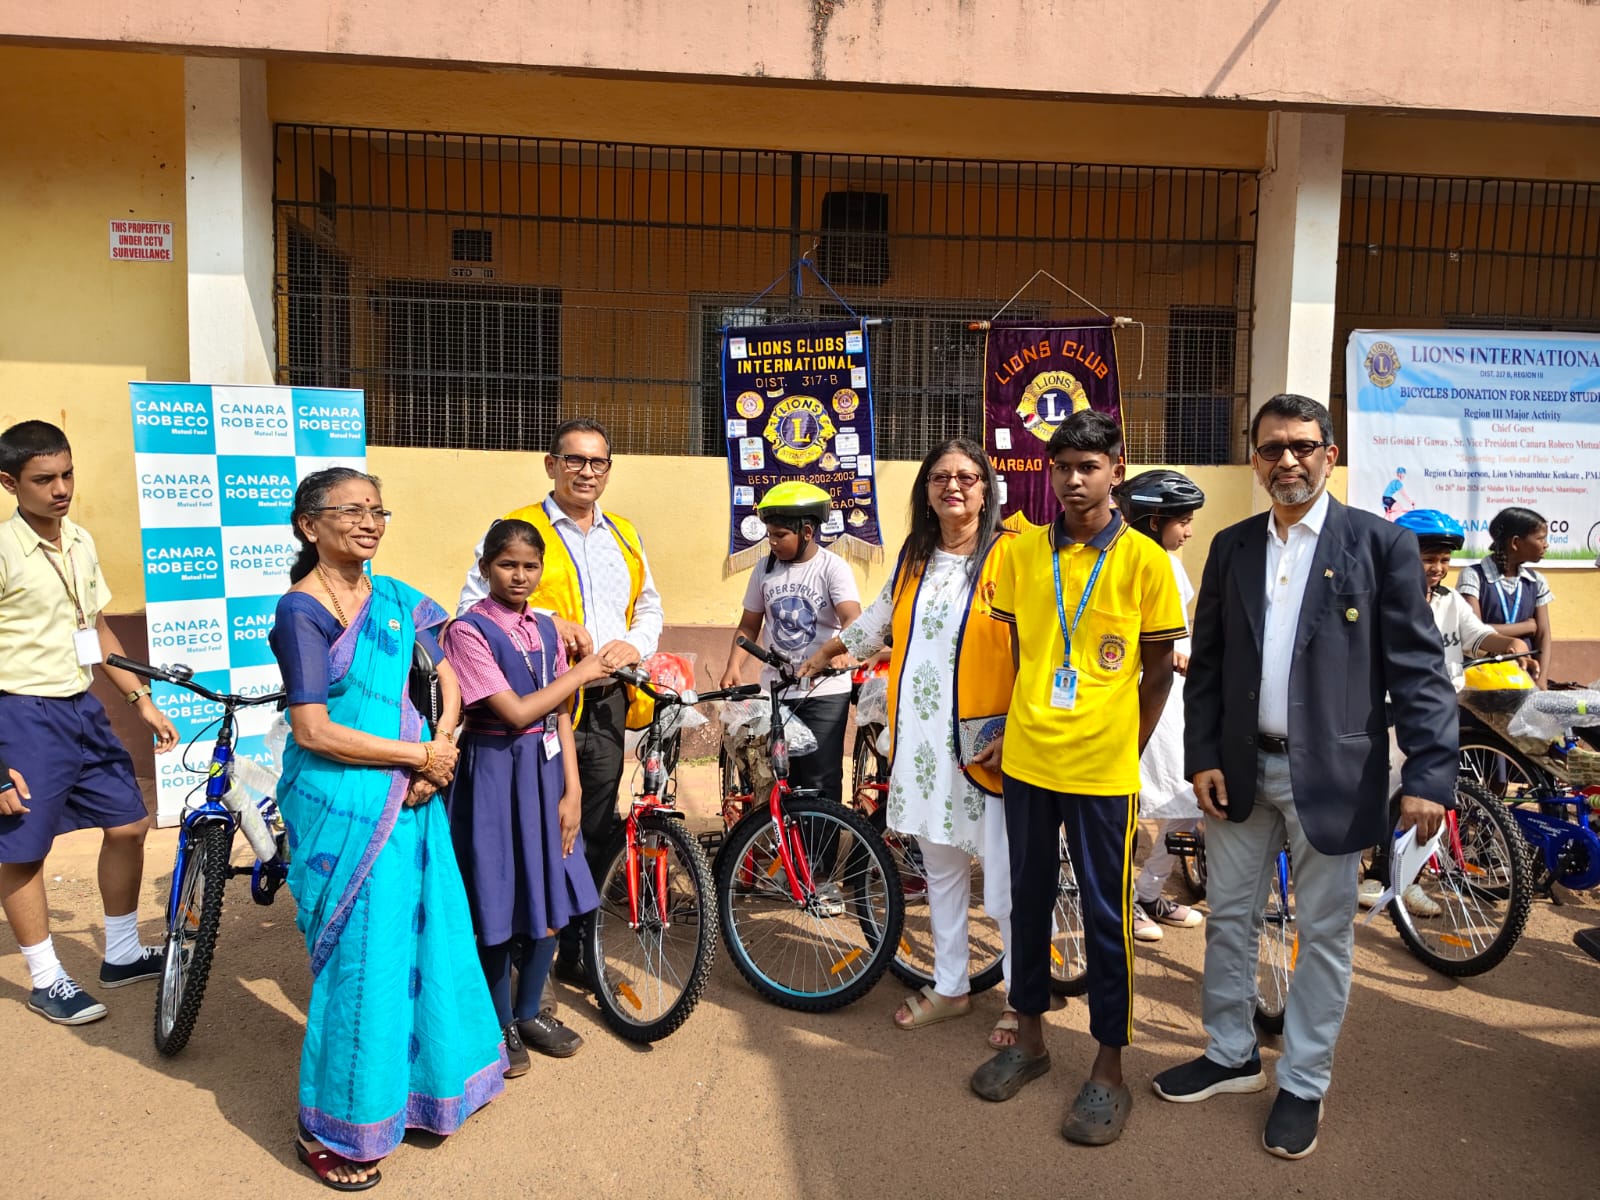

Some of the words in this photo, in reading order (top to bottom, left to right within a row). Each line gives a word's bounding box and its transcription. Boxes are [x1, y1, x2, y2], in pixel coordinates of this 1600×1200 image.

[111, 222, 127, 232] THIS
[128, 223, 162, 234] PROPERTY
[163, 224, 170, 234] IS
[119, 235, 142, 245] UNDER
[144, 236, 163, 247] CCTV
[113, 247, 170, 259] SURVEILLANCE
[451, 268, 473, 277] STD
[748, 340, 792, 356] LIONS
[797, 337, 844, 353] CLUBS
[994, 340, 1051, 385] LIONS
[1062, 340, 1109, 380] CLUB
[1411, 346, 1465, 364] LIONS
[1470, 348, 1600, 368] INTERNATIONA
[738, 355, 856, 374] INTERNATIONAL
[755, 376, 788, 388] DIST.
[802, 375, 838, 387] 317-B
[1514, 371, 1536, 379] REGION
[1036, 374, 1071, 391] LIONS
[1400, 387, 1448, 399] BICYCLES
[1450, 388, 1507, 401] DONATION
[1510, 389, 1530, 401] FOR
[1533, 390, 1568, 402] NEEDY
[136, 400, 206, 413] CANARA
[220, 403, 286, 415] CANARA
[298, 406, 361, 418] CANARA
[779, 399, 821, 414] LIONS
[1043, 393, 1066, 422] L
[136, 415, 209, 428] ROBECO
[1464, 408, 1490, 420] Region
[1493, 408, 1503, 418] III
[1505, 409, 1529, 421] Major
[1531, 410, 1560, 422] Activity
[221, 417, 288, 429] ROBECO
[299, 419, 362, 431] ROBECO
[1491, 423, 1511, 433] Chief
[1513, 424, 1535, 433] Guest
[791, 418, 811, 443] L
[1372, 435, 1388, 446] Shri
[1390, 435, 1415, 446] Govind
[1466, 437, 1482, 447] Vice
[1484, 438, 1518, 448] President
[1548, 439, 1574, 449] Robeco
[989, 457, 1042, 472] MARGAO
[142, 474, 211, 486] CANARA
[225, 474, 290, 486] CANARA
[748, 475, 776, 485] BEST
[1424, 468, 1447, 479] Region
[1448, 469, 1490, 480] Chairperson,
[1492, 469, 1507, 478] Lion
[142, 488, 213, 500] ROBECO
[226, 488, 293, 499] ROBECO
[829, 487, 842, 497] OF
[1521, 485, 1535, 493] High
[831, 498, 855, 509] GAO
[1461, 520, 1489, 532] ANA
[1549, 535, 1568, 544] Fund
[146, 546, 216, 560] CANARA
[229, 543, 295, 556] CANARA
[147, 560, 218, 574] ROBECO
[765, 583, 827, 609] UPERSTRIKER
[152, 618, 220, 634] CANARA
[233, 613, 276, 627] CANA
[152, 632, 223, 647] ROBECO
[234, 628, 267, 641] ROB
[238, 683, 282, 697] CANA
[161, 760, 208, 775] CANA
